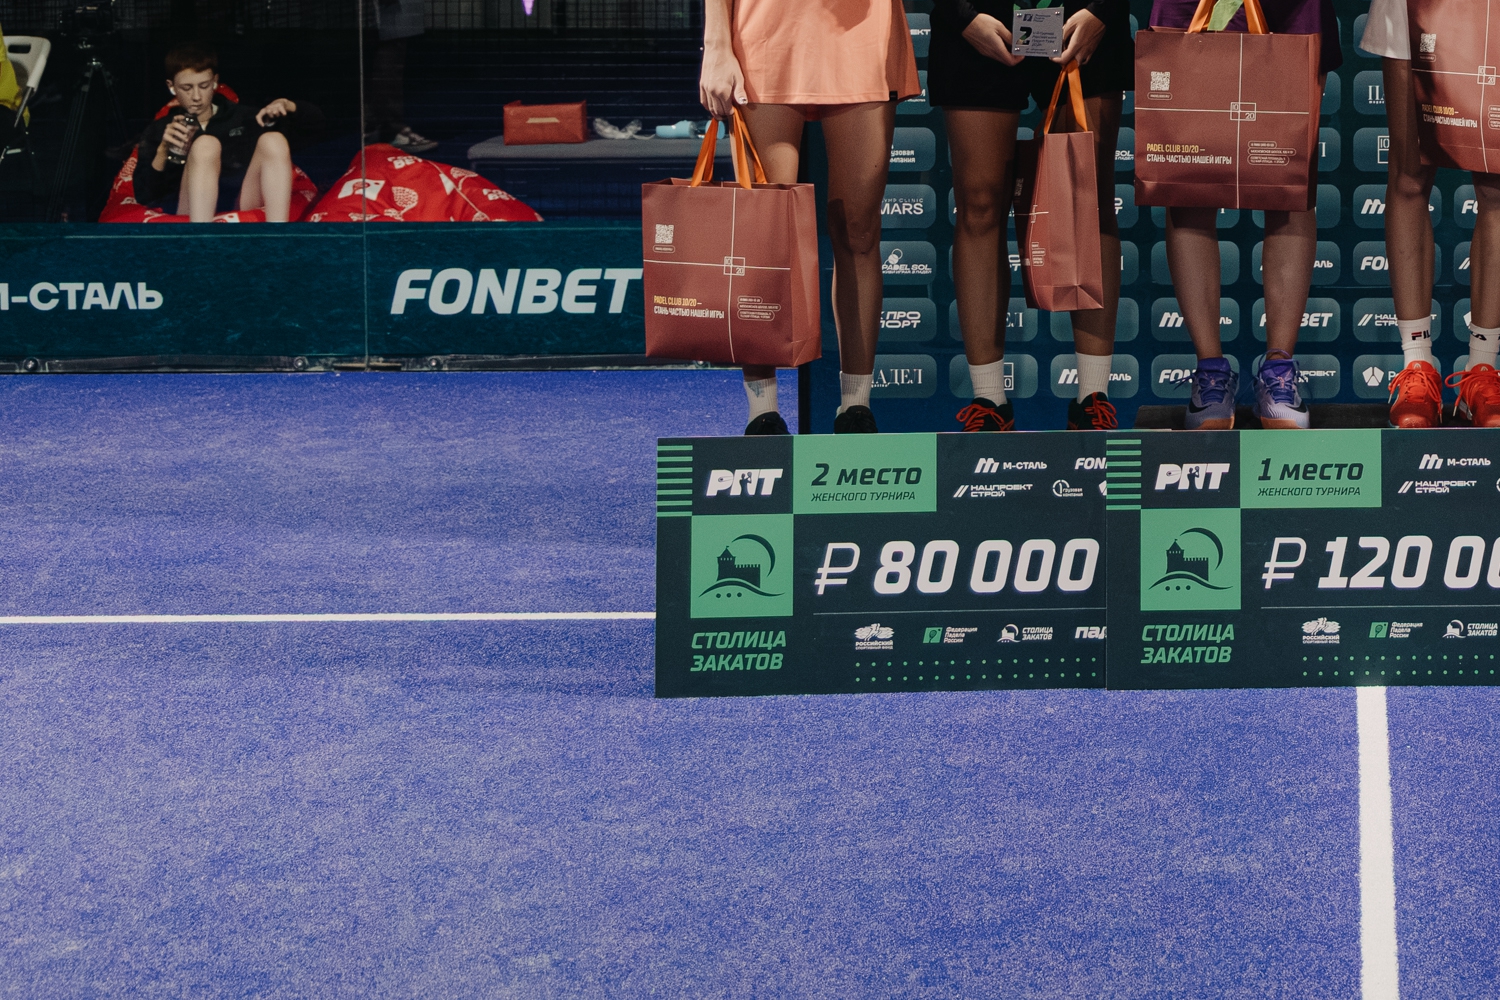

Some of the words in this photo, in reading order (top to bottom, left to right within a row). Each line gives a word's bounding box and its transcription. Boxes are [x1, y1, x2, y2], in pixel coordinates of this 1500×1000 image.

[1016, 27, 1033, 46] 2
[1245, 112, 1255, 120] 20
[1147, 143, 1164, 152] PADEL
[1165, 144, 1181, 153] CLUB
[1181, 145, 1199, 153] 10/20
[1147, 154, 1165, 162] СТАНЬ
[1166, 155, 1191, 163] ЧАСТЬЮ
[1192, 155, 1214, 164] НАШЕЙ
[1214, 156, 1232, 164] ИГРЫ
[880, 203, 924, 215] MARS
[0, 282, 164, 310] -СТАЛЬ
[390, 268, 643, 315] FONBET
[654, 296, 667, 305] PADEL
[668, 297, 681, 305] CLUB
[681, 298, 697, 307] 10/20
[654, 306, 668, 315] СТАНЬ
[669, 307, 690, 316] ЧАСТЬЮ
[690, 308, 709, 318] НАШЕЙ
[710, 310, 724, 318] ИГРЫ
[886, 311, 921, 320] ПРО
[1003, 462, 1047, 470] М-СТАЛЬ
[1447, 458, 1491, 466] М-СТАЛЬ
[812, 463, 830, 486] 2
[836, 466, 922, 486] место
[1257, 458, 1272, 481] 1
[1279, 460, 1364, 481] место
[811, 493, 867, 502] ЖЕНСКОГО
[868, 491, 916, 501] ТУРНИРА
[1257, 487, 1312, 497] ЖЕНСКОГО
[1314, 487, 1361, 497] ТУРНИРА
[873, 540, 960, 595] 80
[970, 538, 1100, 593] 000
[1318, 535, 1434, 589] 120
[1022, 626, 1053, 634] СТОЛИЦА
[1391, 621, 1423, 629] Федерация
[1022, 633, 1053, 641] ЗАКАТОВ
[1141, 623, 1235, 643] СТОЛИЦА
[1467, 629, 1498, 637] ЗАКАТОВ
[691, 630, 786, 651] СТОЛИЦА
[1140, 646, 1232, 664] ЗАКАТОВ
[690, 653, 784, 672] ЗАКАТОВ
